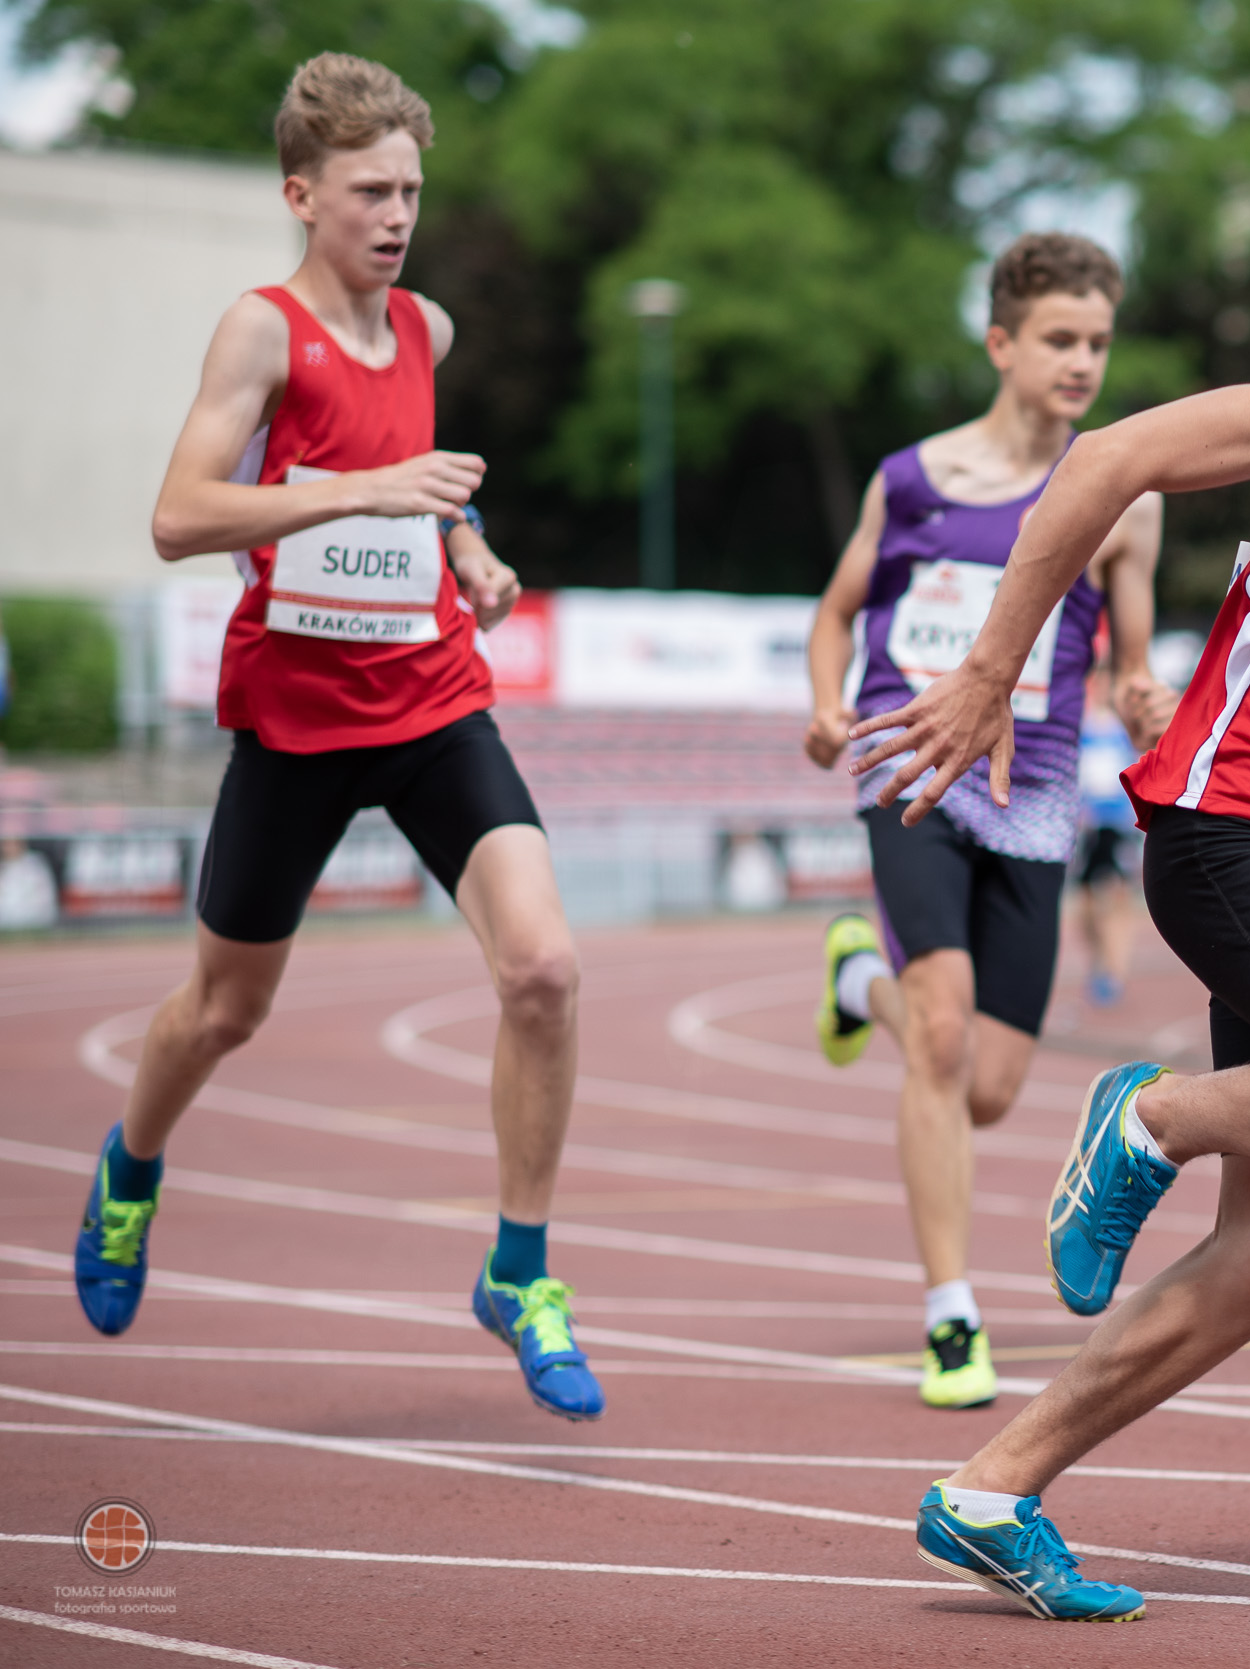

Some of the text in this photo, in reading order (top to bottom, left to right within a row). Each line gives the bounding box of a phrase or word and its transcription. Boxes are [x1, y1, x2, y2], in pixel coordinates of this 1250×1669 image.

[322, 545, 411, 579] SUDER
[298, 611, 377, 635] KRAKÓW
[381, 618, 412, 636] 2019
